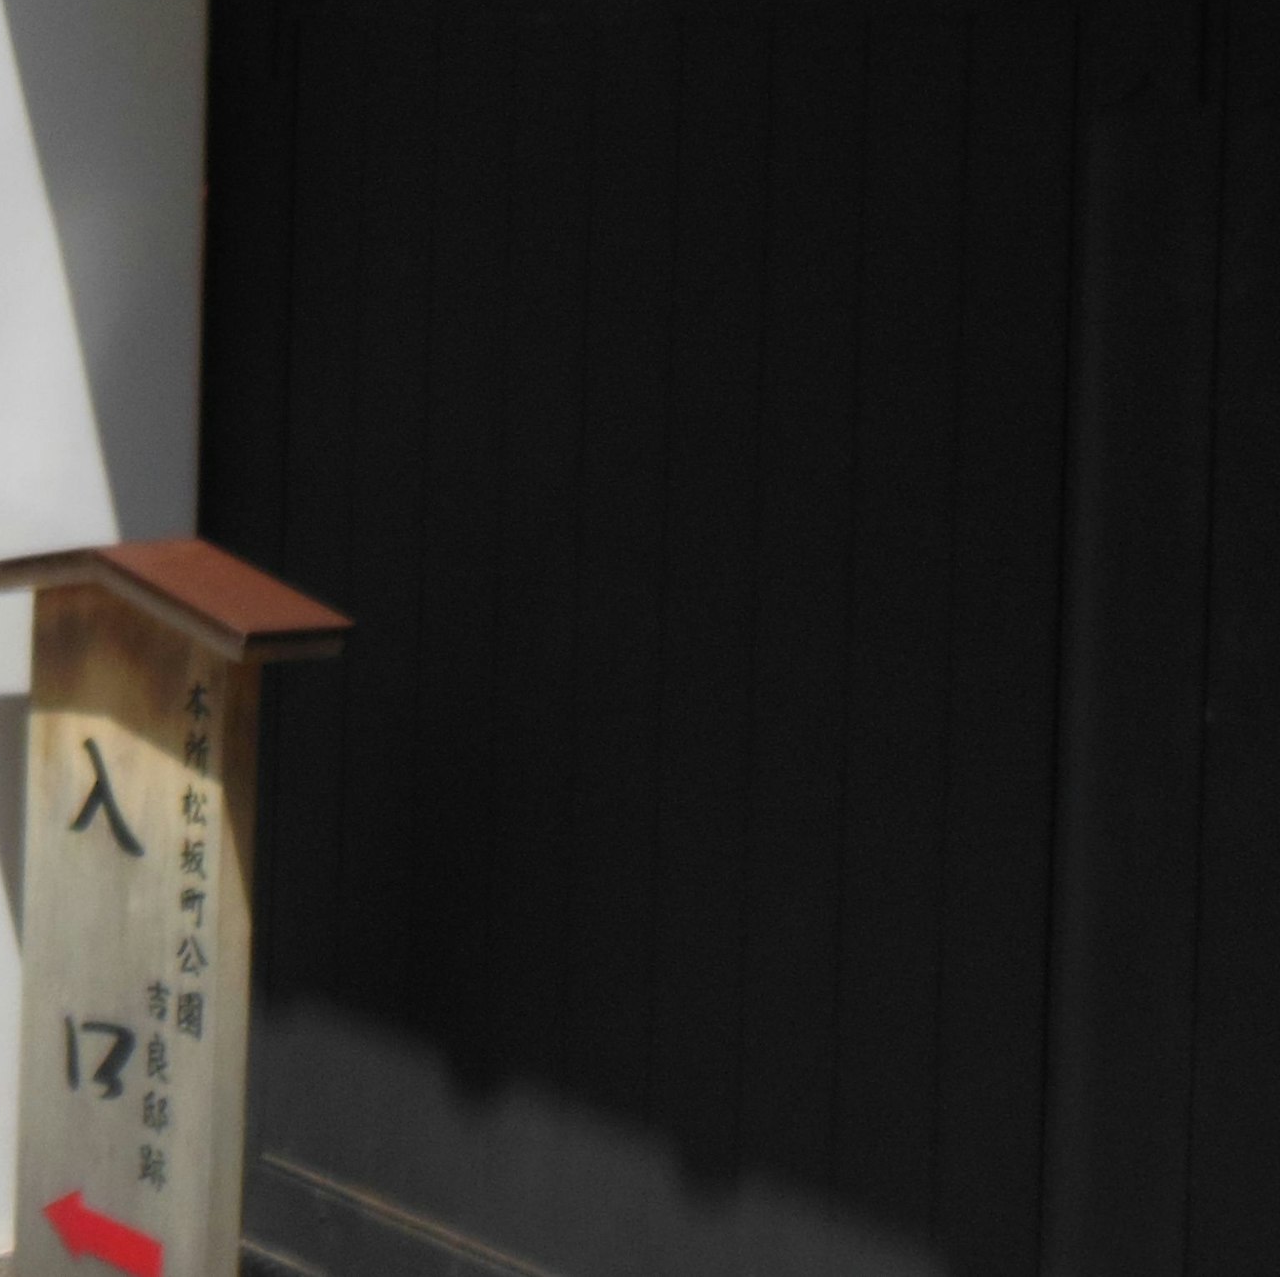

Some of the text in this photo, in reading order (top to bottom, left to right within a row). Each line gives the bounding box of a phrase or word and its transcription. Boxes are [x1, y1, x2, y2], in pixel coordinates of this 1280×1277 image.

[65, 736, 144, 1100] 入口
[175, 680, 210, 1041] 本所松坂町公園
[138, 979, 170, 1193] 吉良邸跡
